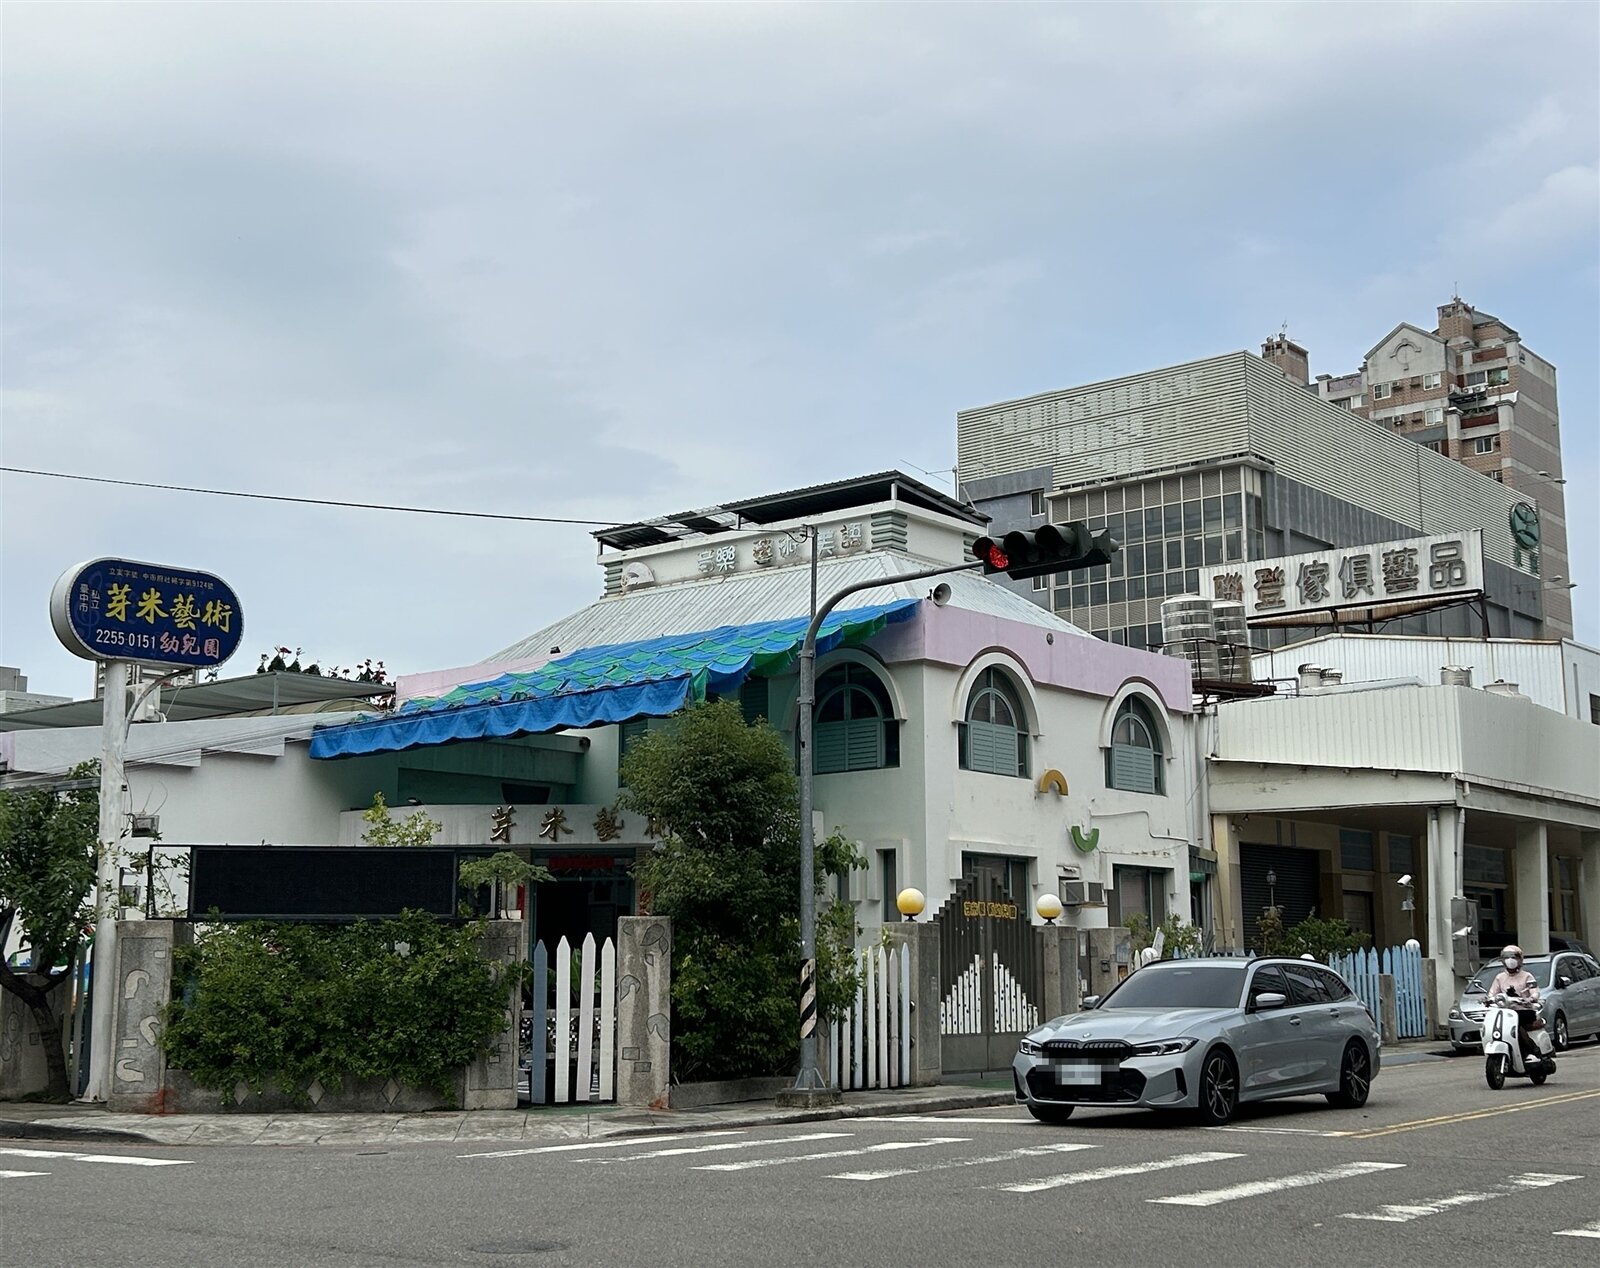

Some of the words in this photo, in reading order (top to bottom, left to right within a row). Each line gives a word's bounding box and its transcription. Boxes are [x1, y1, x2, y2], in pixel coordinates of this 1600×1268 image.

[105, 583, 233, 633] 芽米藝術
[159, 631, 220, 659] 幼兒園
